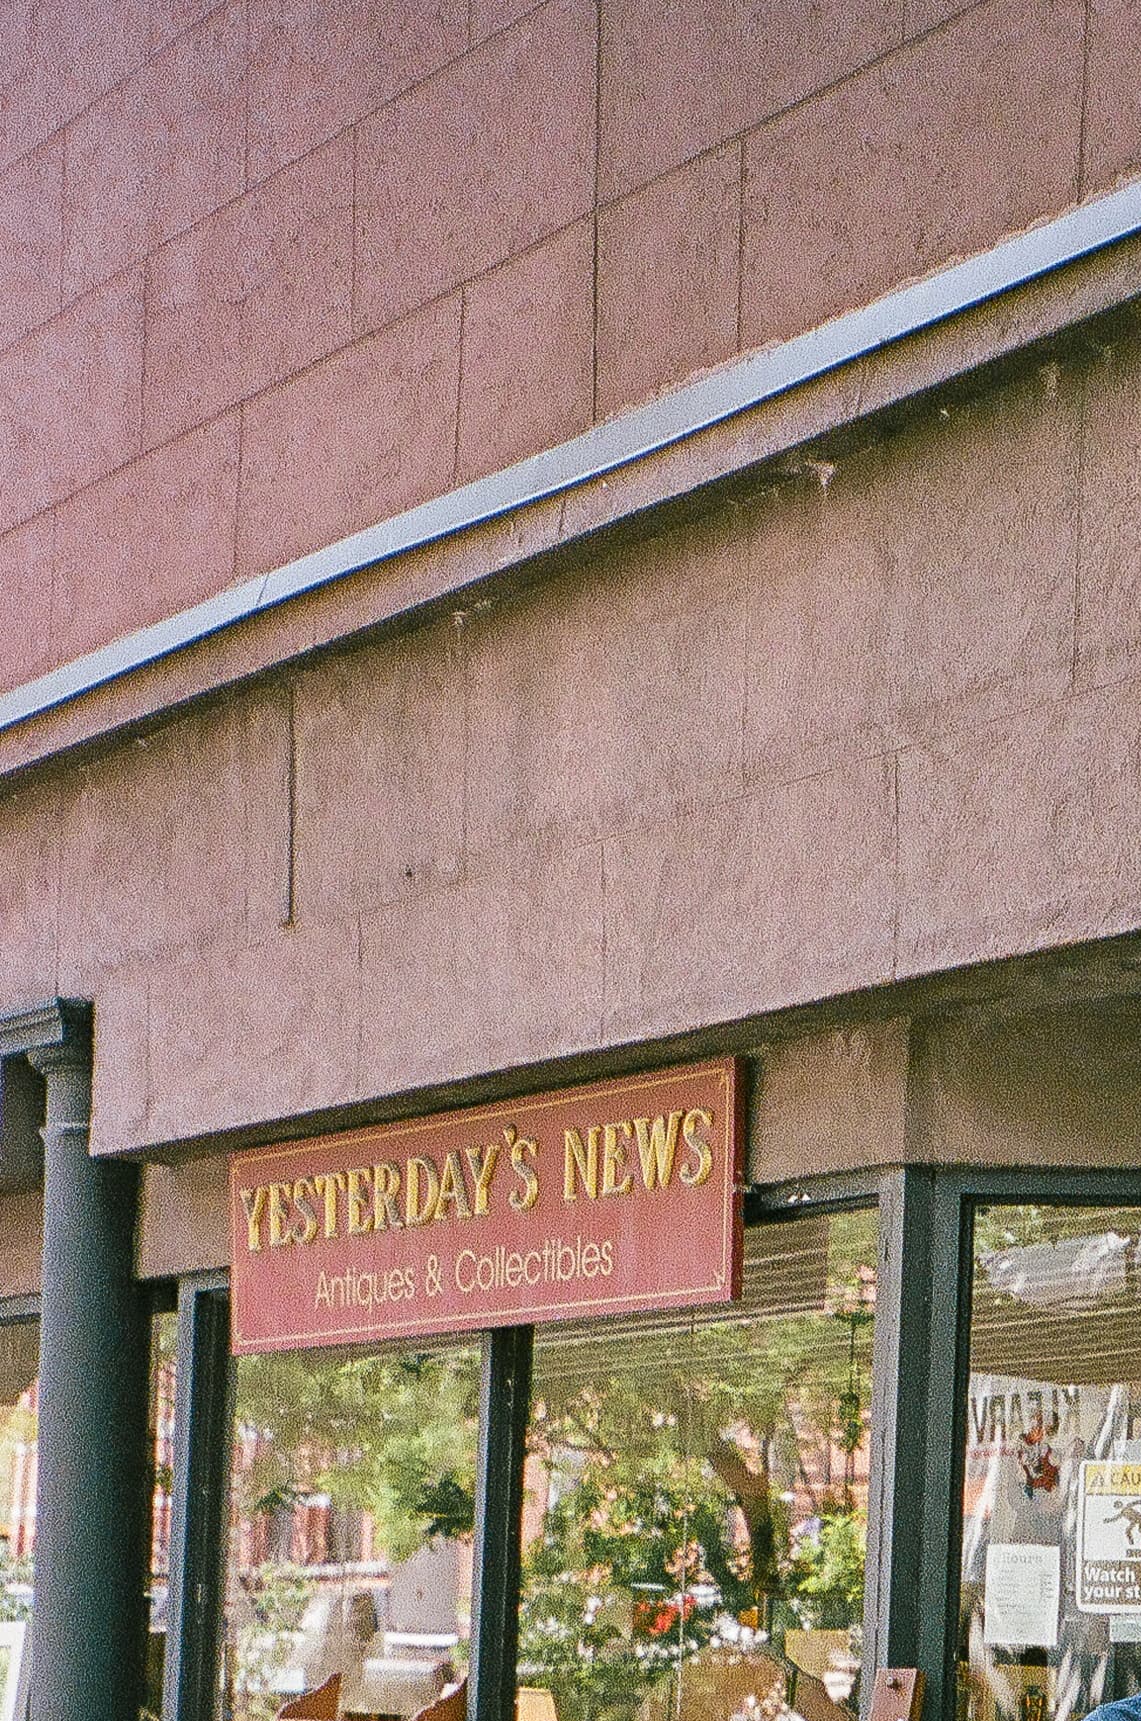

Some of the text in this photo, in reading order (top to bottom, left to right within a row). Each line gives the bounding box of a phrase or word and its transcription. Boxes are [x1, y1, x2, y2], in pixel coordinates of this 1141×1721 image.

[241, 1108, 713, 1252] YESTERDAY'S NEWS
[314, 1238, 613, 1310] Antiques & Collectibles
[1084, 1566, 1136, 1583] Watch
[1084, 1586, 1122, 1601] your
